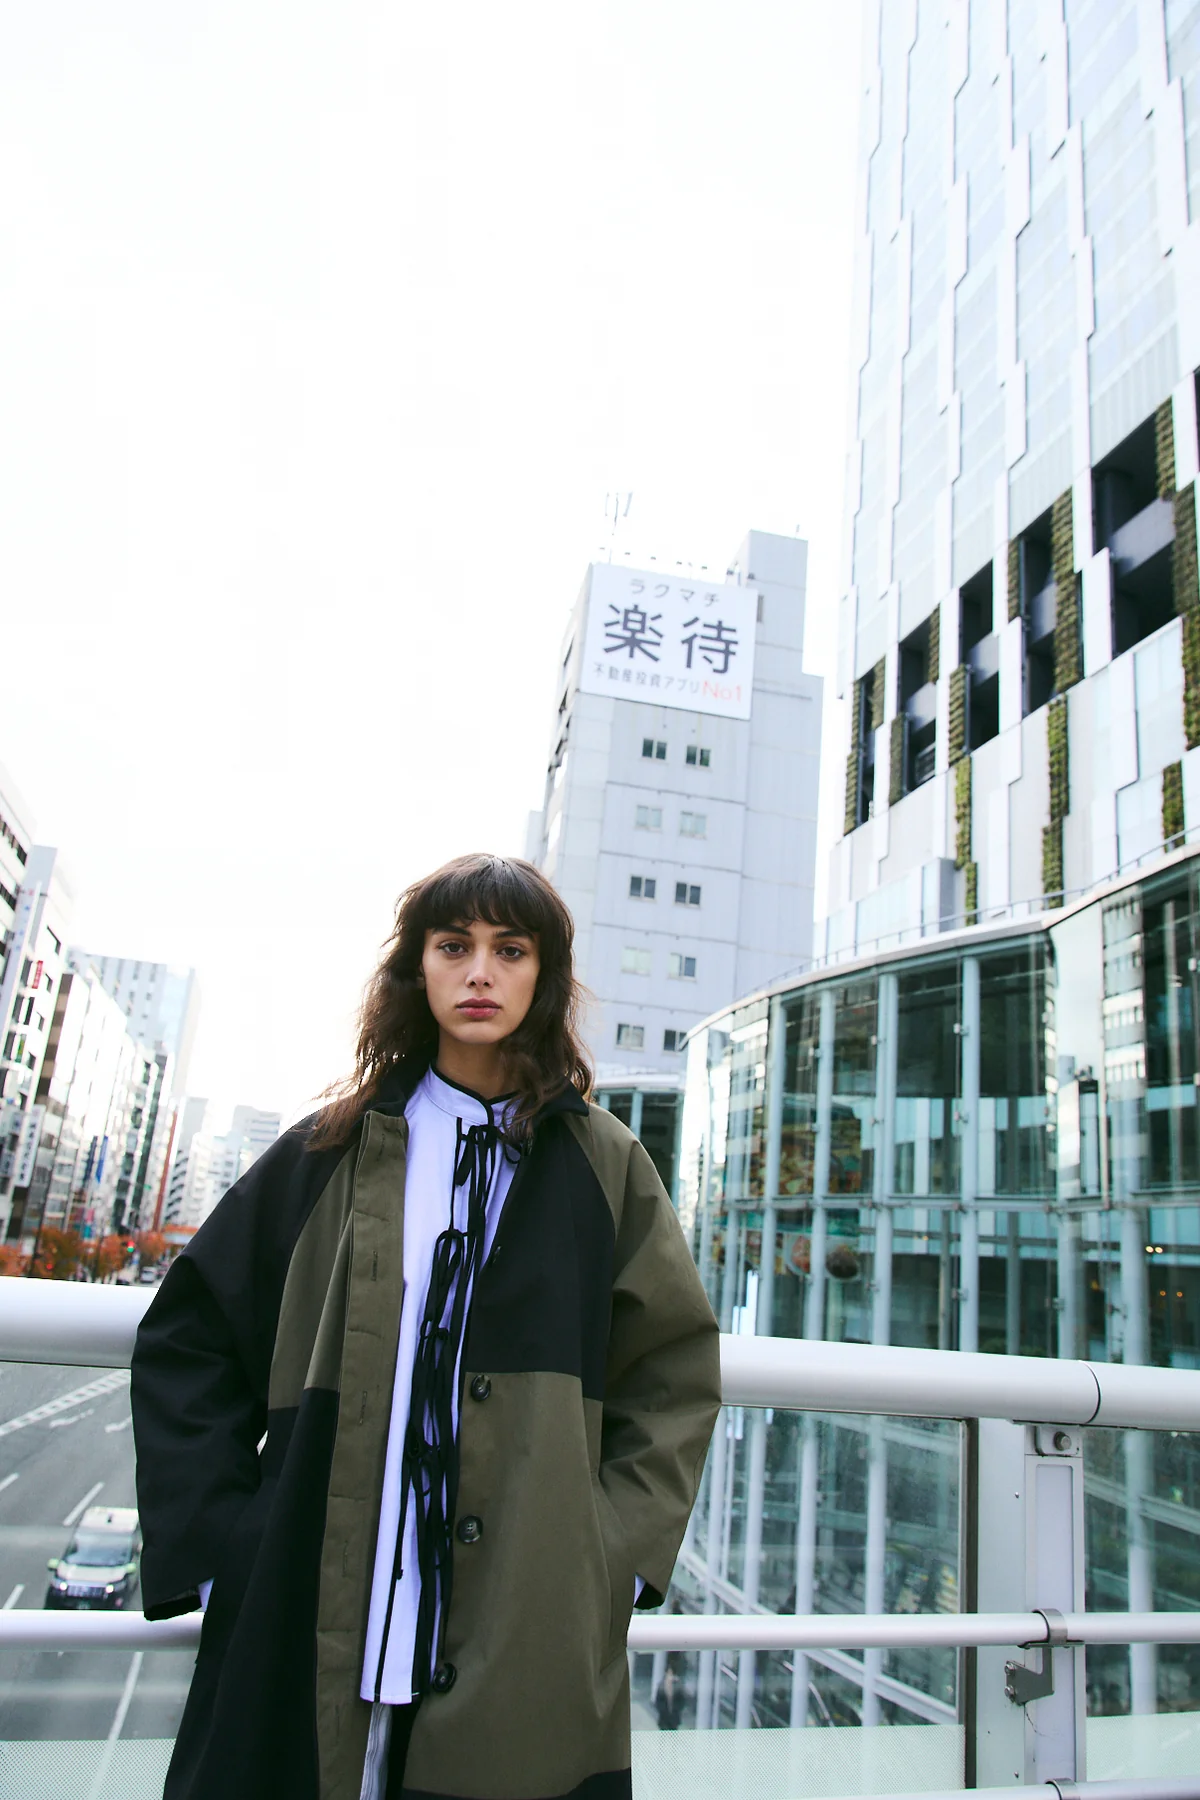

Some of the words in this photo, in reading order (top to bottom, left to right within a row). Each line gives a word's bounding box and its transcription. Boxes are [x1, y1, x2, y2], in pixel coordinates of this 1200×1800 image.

[630, 579, 720, 607] ラクマチ
[603, 604, 738, 674] 楽待
